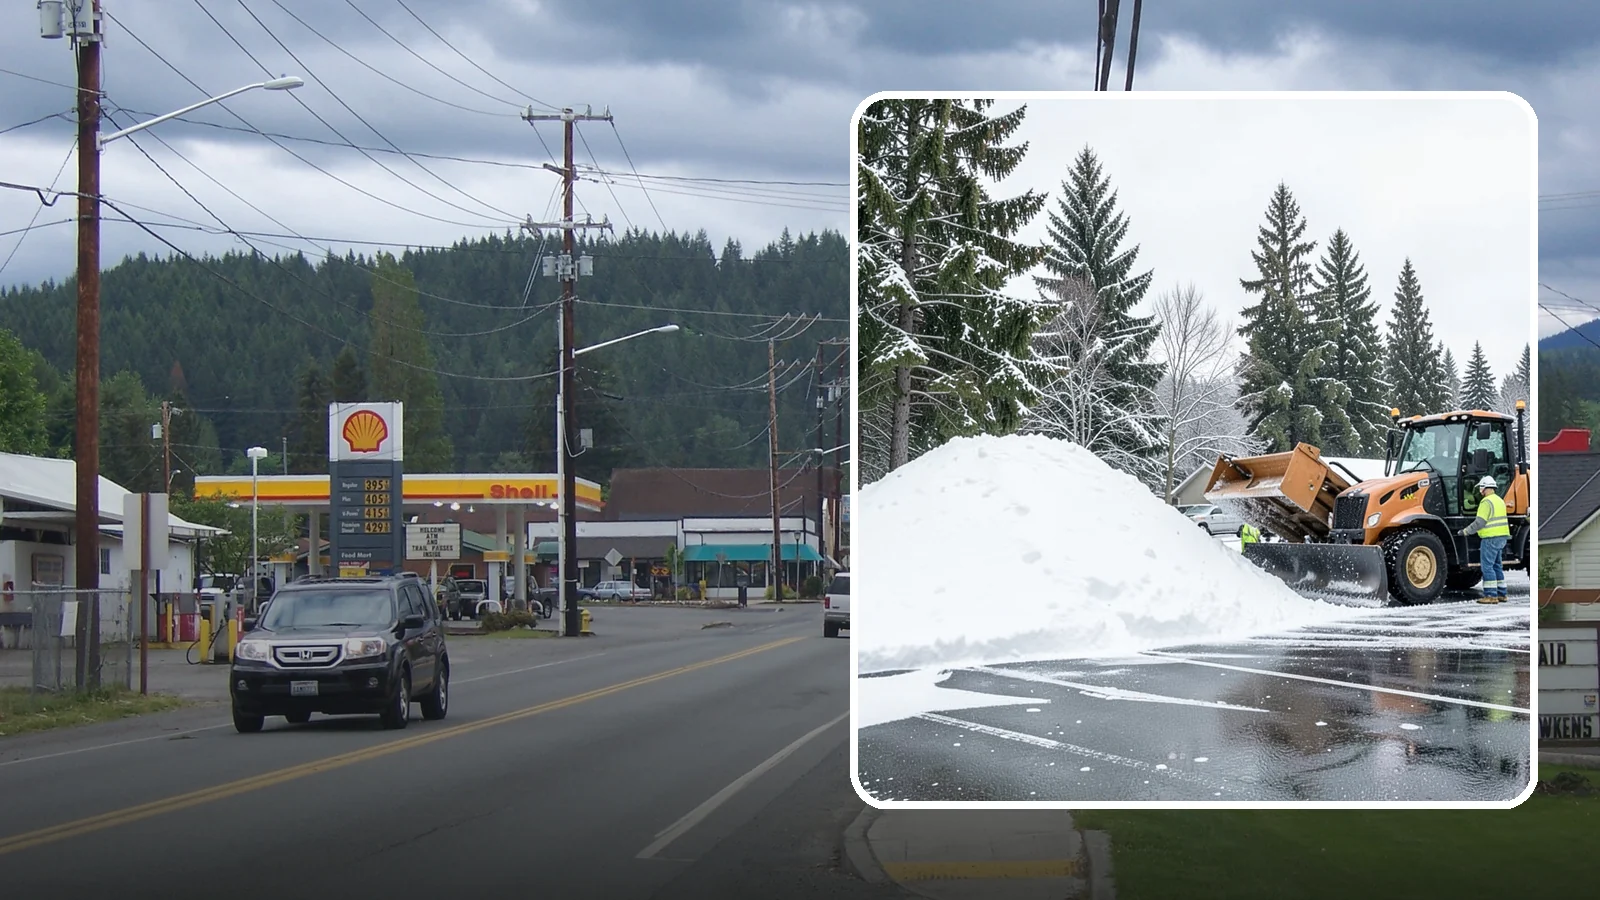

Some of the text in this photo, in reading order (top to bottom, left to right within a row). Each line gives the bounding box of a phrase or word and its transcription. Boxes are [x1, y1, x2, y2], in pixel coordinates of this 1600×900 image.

[366, 480, 383, 490] 395
[490, 484, 547, 499] Shell
[366, 494, 383, 504] 405
[366, 508, 383, 518] 415
